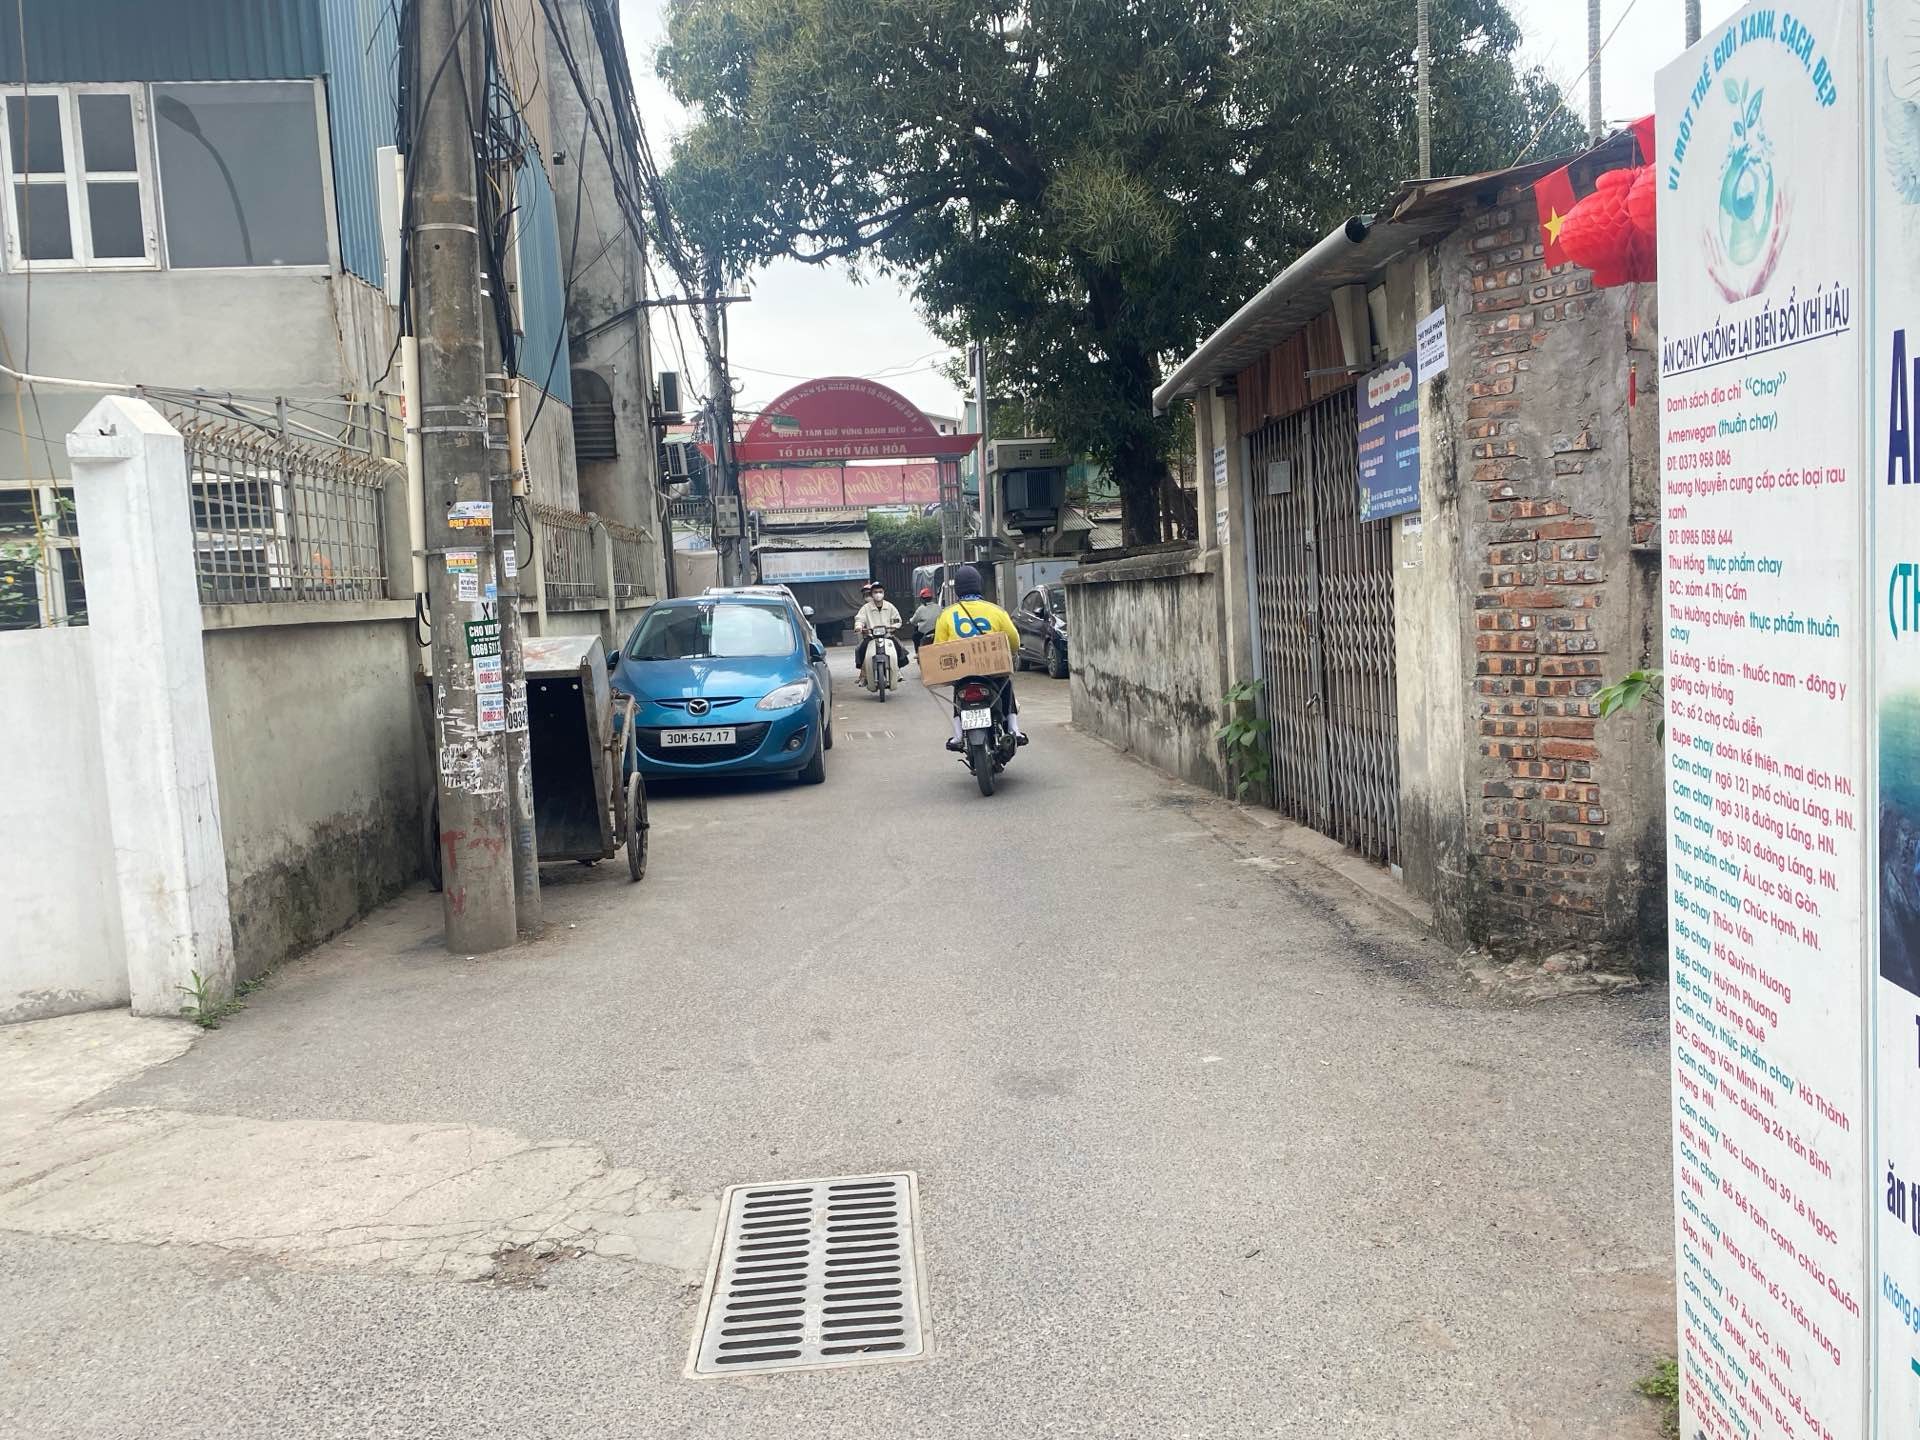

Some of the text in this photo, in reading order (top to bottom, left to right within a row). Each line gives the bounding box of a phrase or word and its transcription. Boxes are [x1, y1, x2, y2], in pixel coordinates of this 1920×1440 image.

[1674, 107, 1694, 163] MỘT
[1713, 27, 1737, 73] GIỚI
[1740, 10, 1777, 46] XANH,
[1780, 13, 1815, 73] SẠCH,
[1662, 336, 1675, 373] ĂN
[1676, 335, 1699, 370] CHAY
[1701, 314, 1736, 363] CHỐNG
[1738, 318, 1752, 360] LẠI
[1754, 298, 1777, 349] BIẾN
[1779, 286, 1800, 342] ĐỔI
[1803, 283, 1822, 336] KHÍ
[1667, 387, 1725, 413] Danh sách địa
[1667, 411, 1778, 444] Amenvegan (thuần chay)
[1679, 449, 1732, 470] 0373 958 086
[1729, 466, 1846, 493] cung cấp các loại rau
[1668, 504, 1688, 520] xanh
[1681, 529, 1733, 545] 0985 058 644
[1669, 552, 1783, 578] Thu phẩm chay
[1669, 580, 1724, 603] ĐC: xóm 4 Thị
[468, 625, 484, 637] CHO
[953, 610, 992, 639] be
[1670, 604, 1840, 638] Thu chuyên thực phẩm thuần
[1670, 626, 1690, 644] chay
[471, 643, 488, 656] 0869
[1670, 649, 1847, 701] Lá xông lá thuốc nam đông y
[1670, 674, 1692, 696] giống
[1671, 700, 1740, 732] ĐC: số 2 chợ cầu
[1672, 727, 1856, 798] Bupe chay dịch HN.
[1692, 760, 1857, 832] chay 121 phố chùa Láng, HN.
[1692, 787, 1838, 857] chay 318 Láng, HN.
[1693, 814, 1839, 892] chay 150 Láng, HN.
[1719, 857, 1821, 918] chay Lạc Sài Gòn.
[1690, 900, 1711, 925] chay
[1719, 888, 1822, 952] chay Chúc Hạnh, HN.
[1691, 929, 1712, 956] chay
[1691, 959, 1712, 985] chay
[1692, 984, 1713, 1009] chay
[1677, 1068, 1699, 1100] Trọng
[1691, 1032, 1777, 1109] Giang Minh HN.
[1769, 1065, 1850, 1133] chay Hà Thành
[1698, 1062, 1833, 1180] chay 26 Bình
[1699, 1117, 1838, 1245] chay Trúc 39 Lê Ngọc
[1886, 1158, 1907, 1224] ăn
[1700, 1161, 1826, 1287] chay cạnh chùa
[1700, 1212, 1789, 1310] chay 2
[1703, 1265, 1740, 1312] chay 147
[1883, 1271, 1911, 1327] Không
[1703, 1296, 1791, 1398] chay khu
[1727, 1354, 1774, 1417] chay Minh
